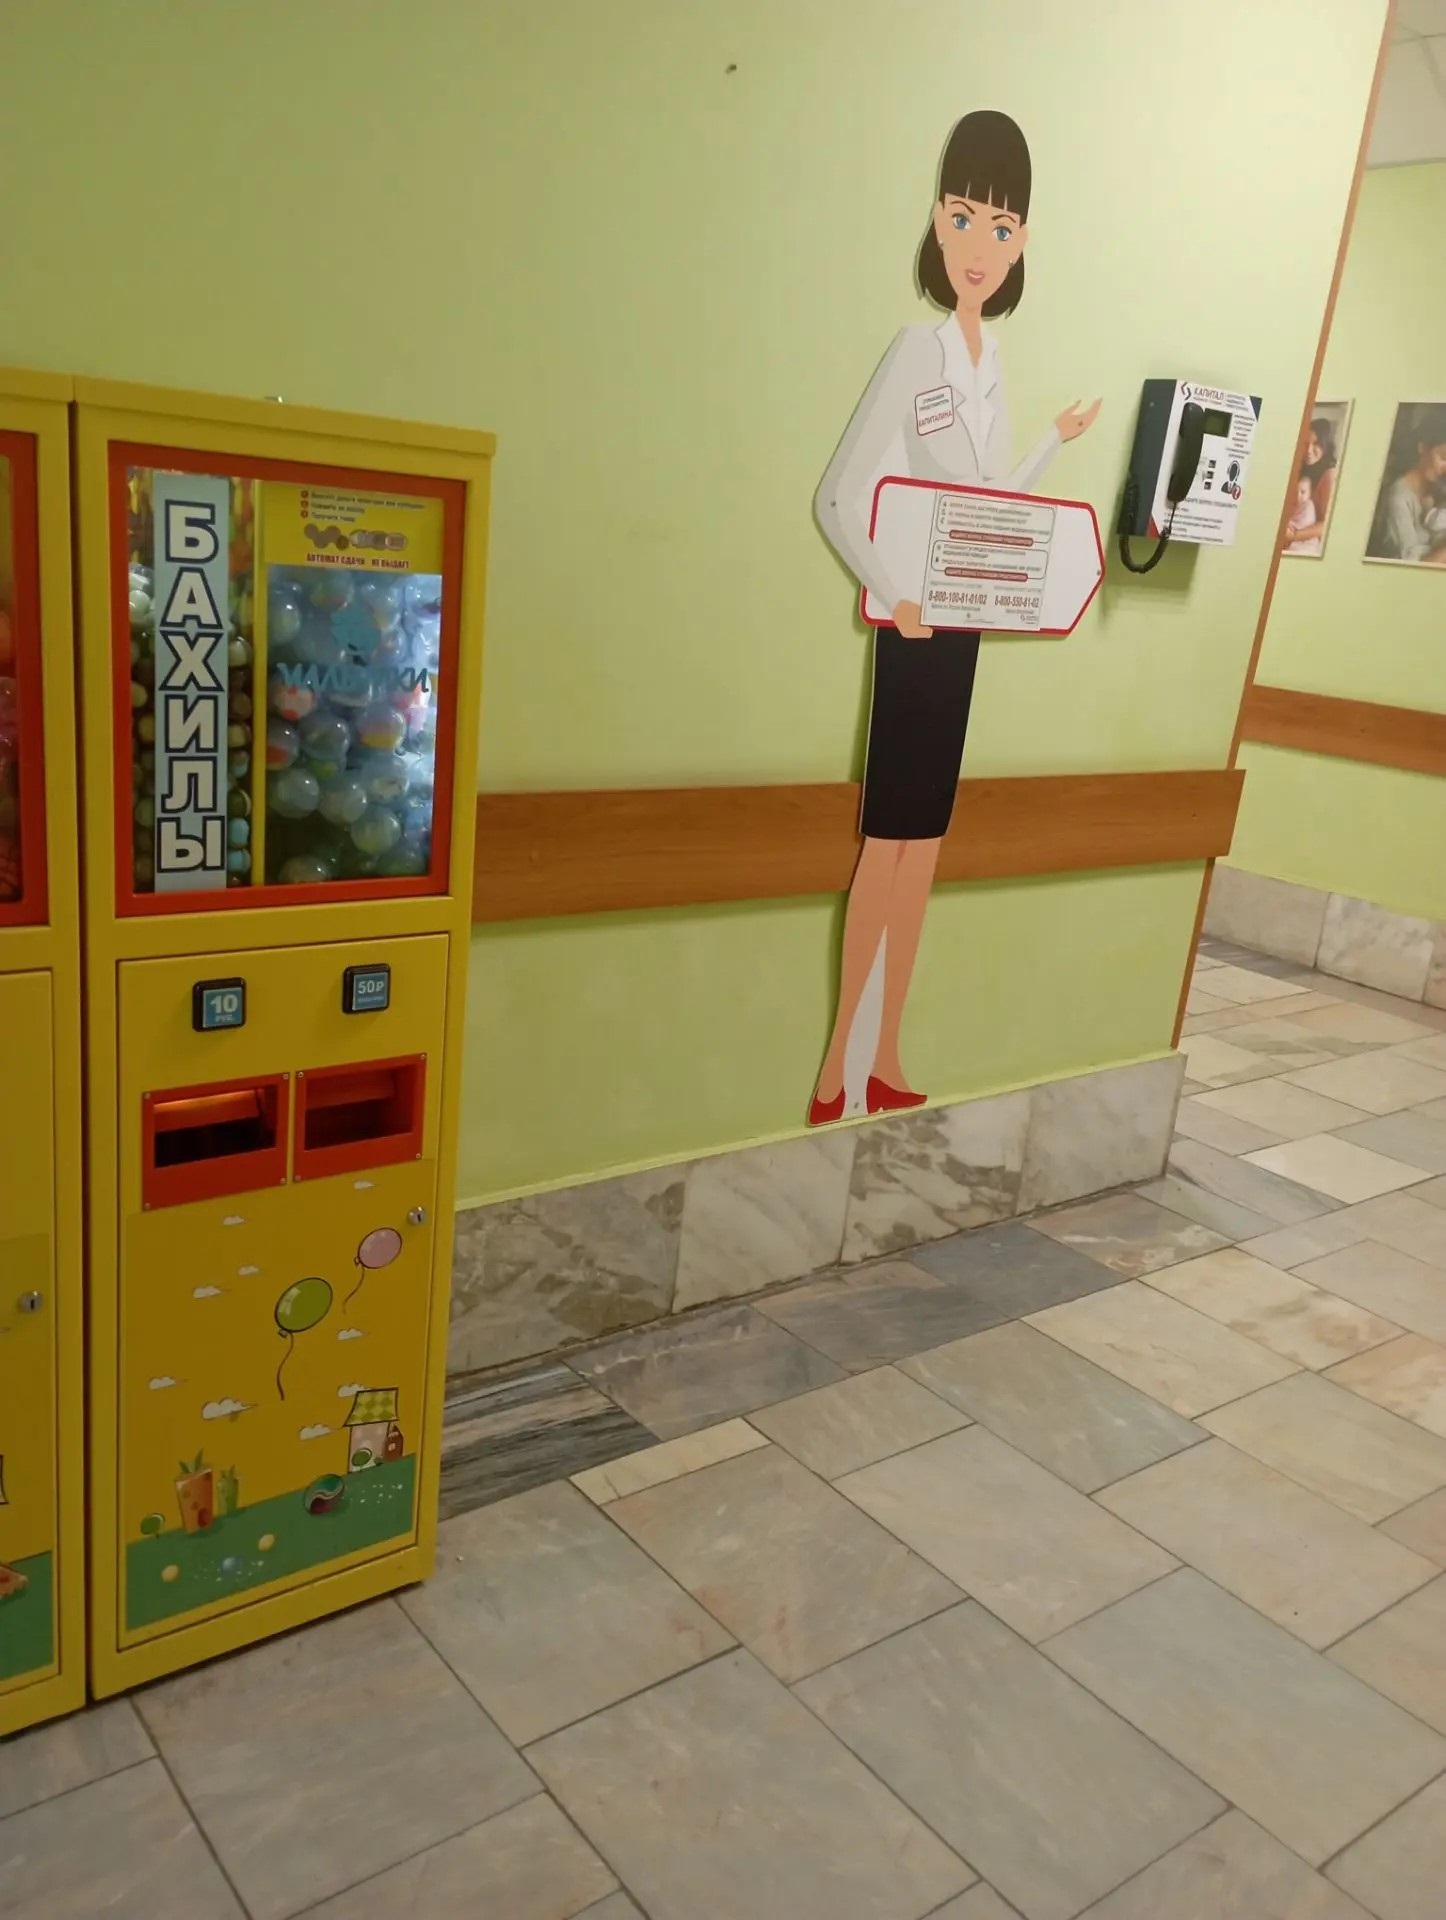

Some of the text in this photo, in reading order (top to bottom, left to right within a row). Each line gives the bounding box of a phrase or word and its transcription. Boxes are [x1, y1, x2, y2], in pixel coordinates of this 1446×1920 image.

[1194, 387, 1225, 401] КАПИТАЛ
[306, 553, 339, 564] АВТОМАТ
[341, 555, 366, 566] СДАЧИ
[156, 498, 226, 874] БАХИЛЫ
[210, 993, 238, 1014] 10
